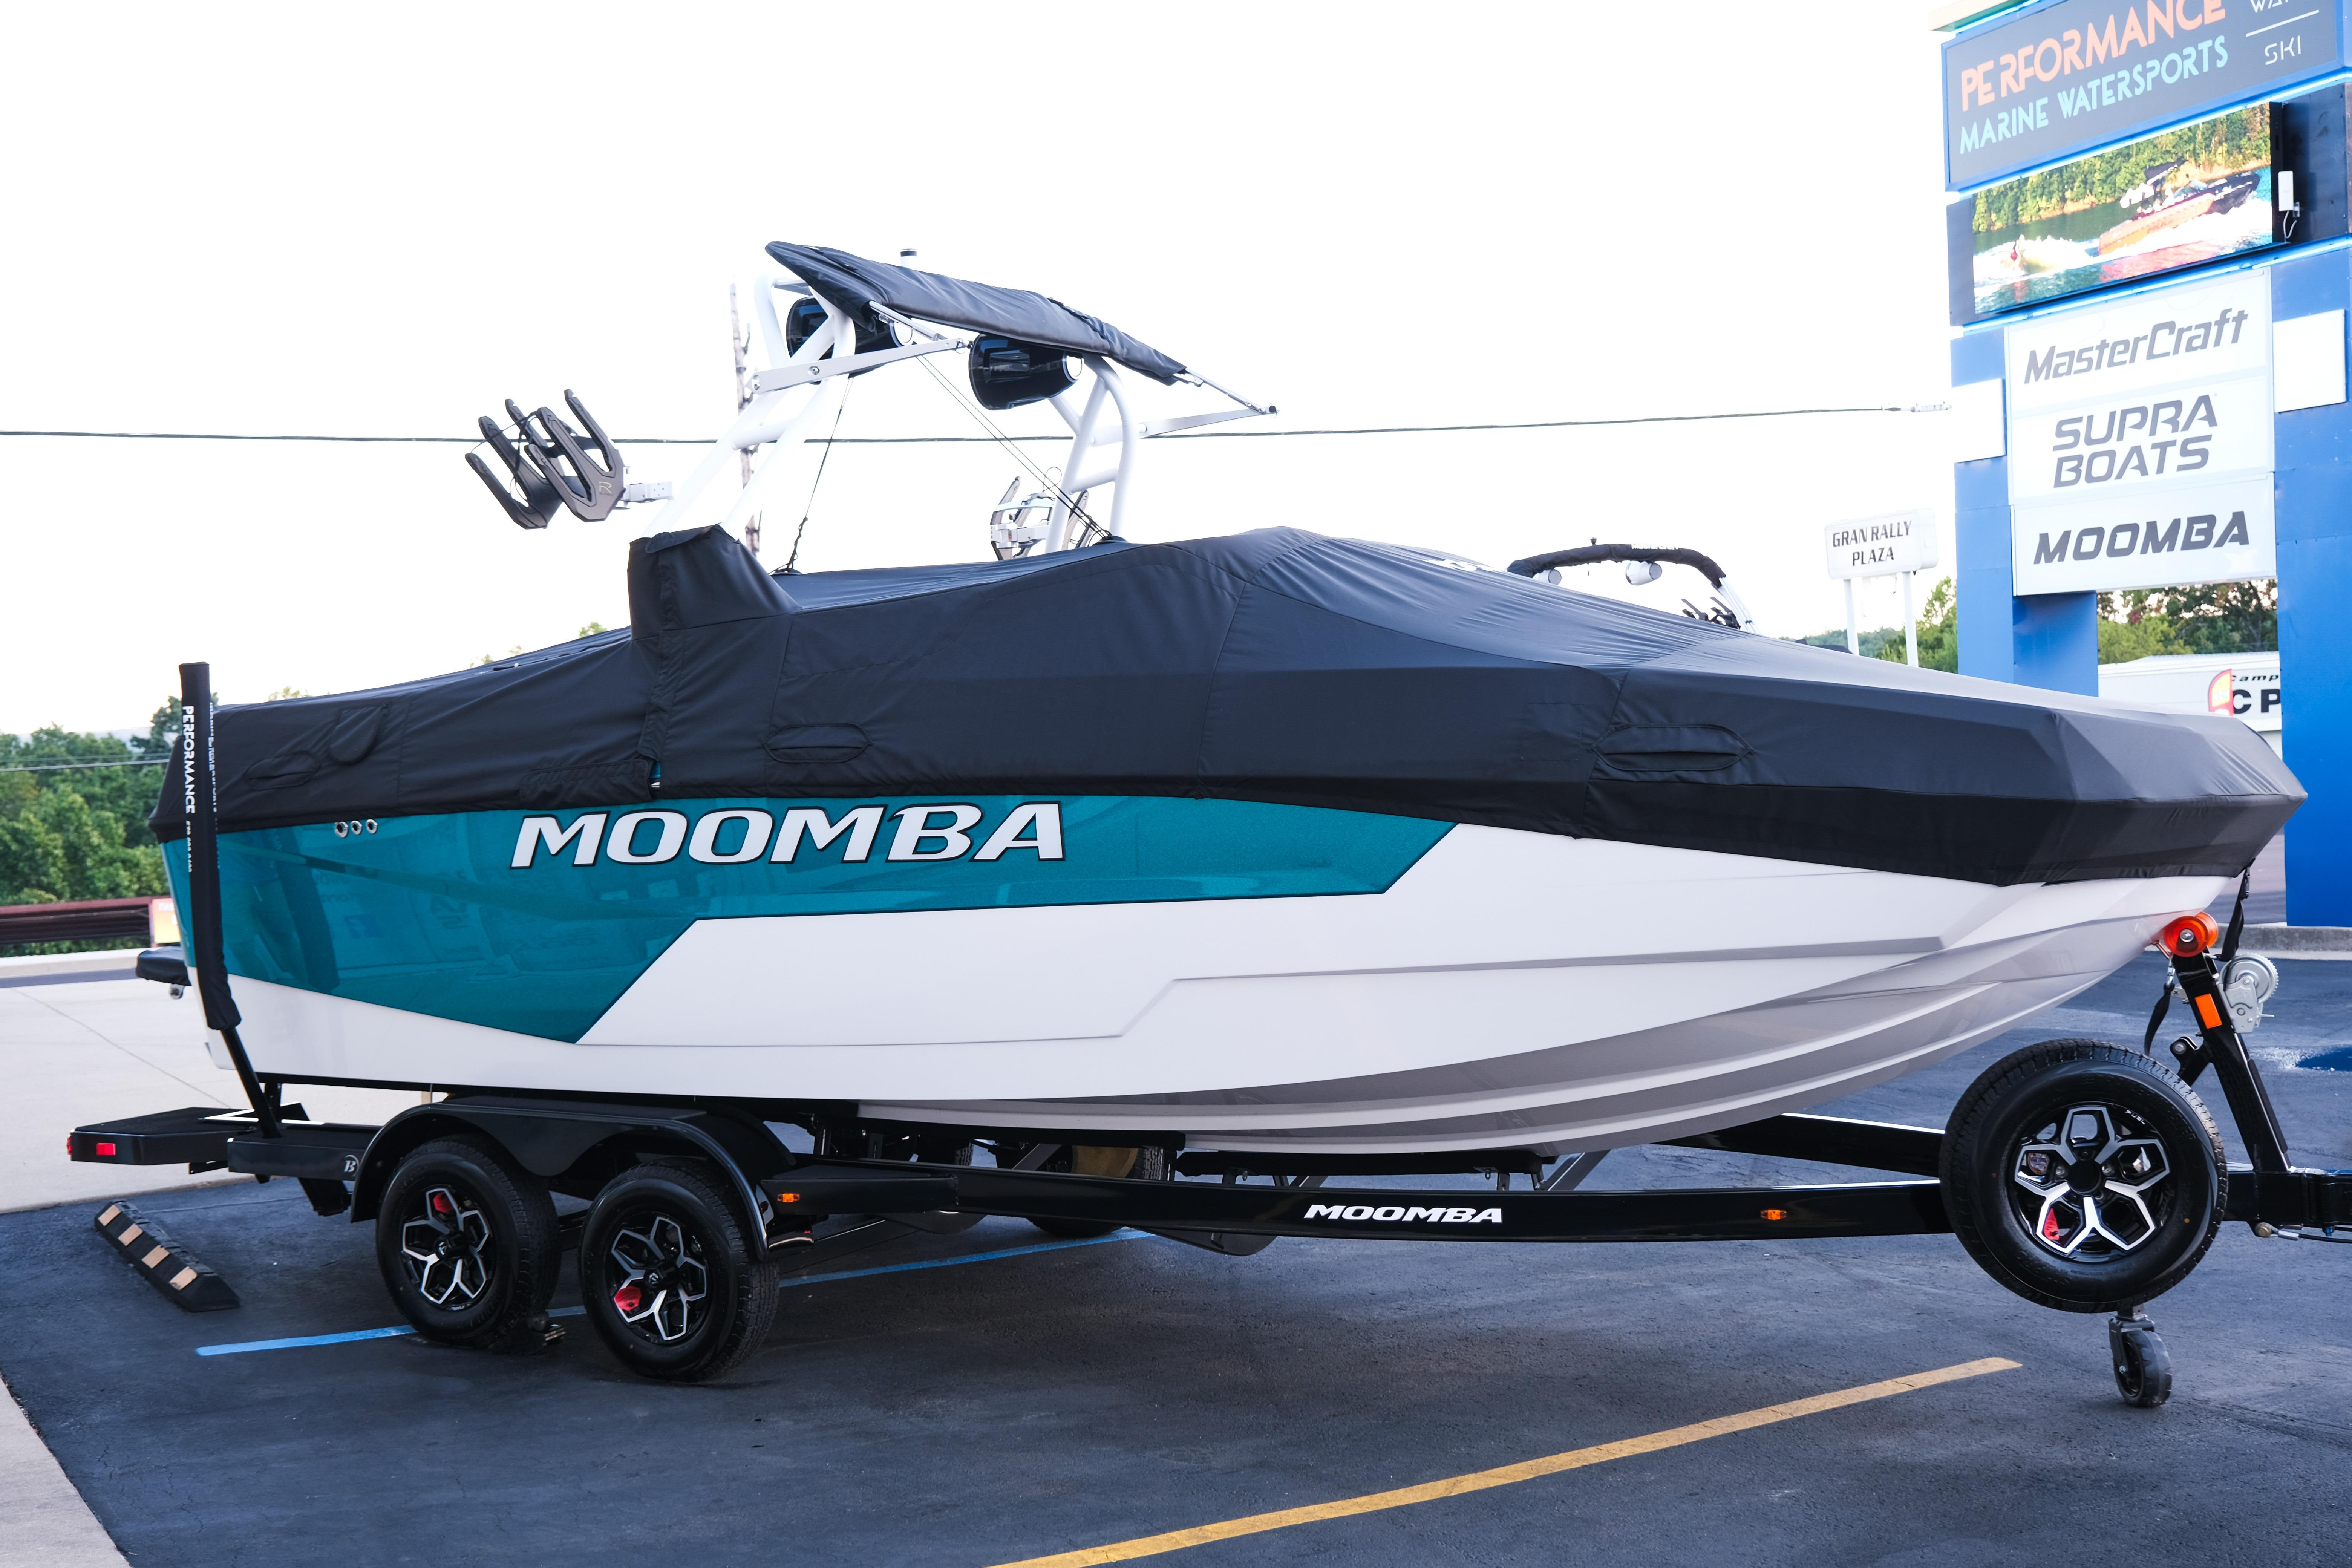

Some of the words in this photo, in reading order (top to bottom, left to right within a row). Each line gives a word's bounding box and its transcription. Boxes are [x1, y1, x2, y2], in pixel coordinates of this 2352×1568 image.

[1961, 0, 2226, 112] PERFORMANCE
[2265, 35, 2301, 65] SKI
[1960, 96, 2049, 155] MARINE
[2057, 35, 2228, 119] WATERSPORTS
[2024, 308, 2249, 384] MasterCraft
[2052, 395, 2218, 451] SUPRA
[2053, 434, 2213, 488] BOATS
[1833, 528, 1867, 547] GRAN
[1871, 520, 1912, 541] RALLY
[1852, 546, 1894, 566] PLAZA
[2033, 511, 2249, 565] MOOMBA
[182, 706, 195, 814] PERFORMANCE
[510, 801, 1066, 869] MOOMBA
[2125, 1110, 2145, 1125] FUEL
[1303, 1204, 1502, 1223] MOOMBA
